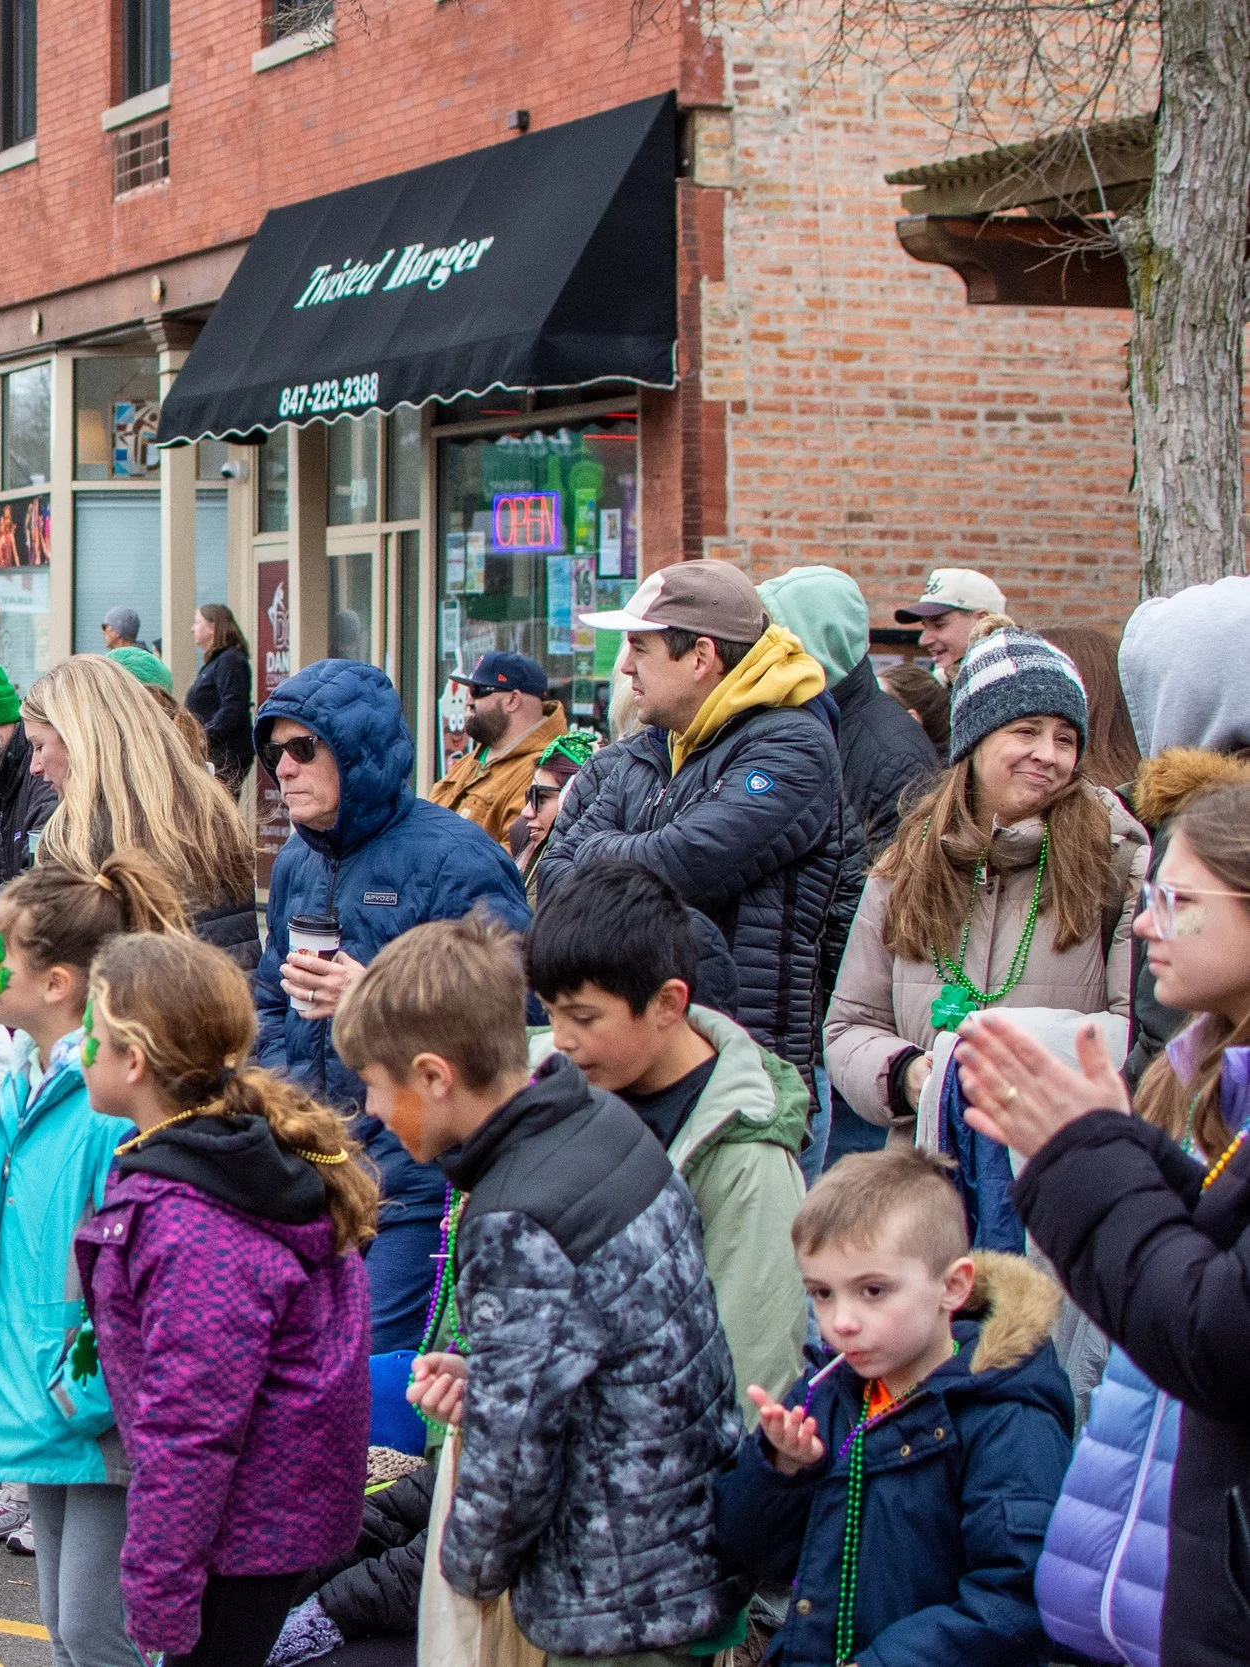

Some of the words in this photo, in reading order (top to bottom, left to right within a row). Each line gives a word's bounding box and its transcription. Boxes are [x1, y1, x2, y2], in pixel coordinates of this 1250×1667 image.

[293, 248, 395, 309] Twisted
[382, 236, 494, 290] Burger
[279, 372, 379, 417] 847-223-2388
[495, 495, 556, 547] OPEN
